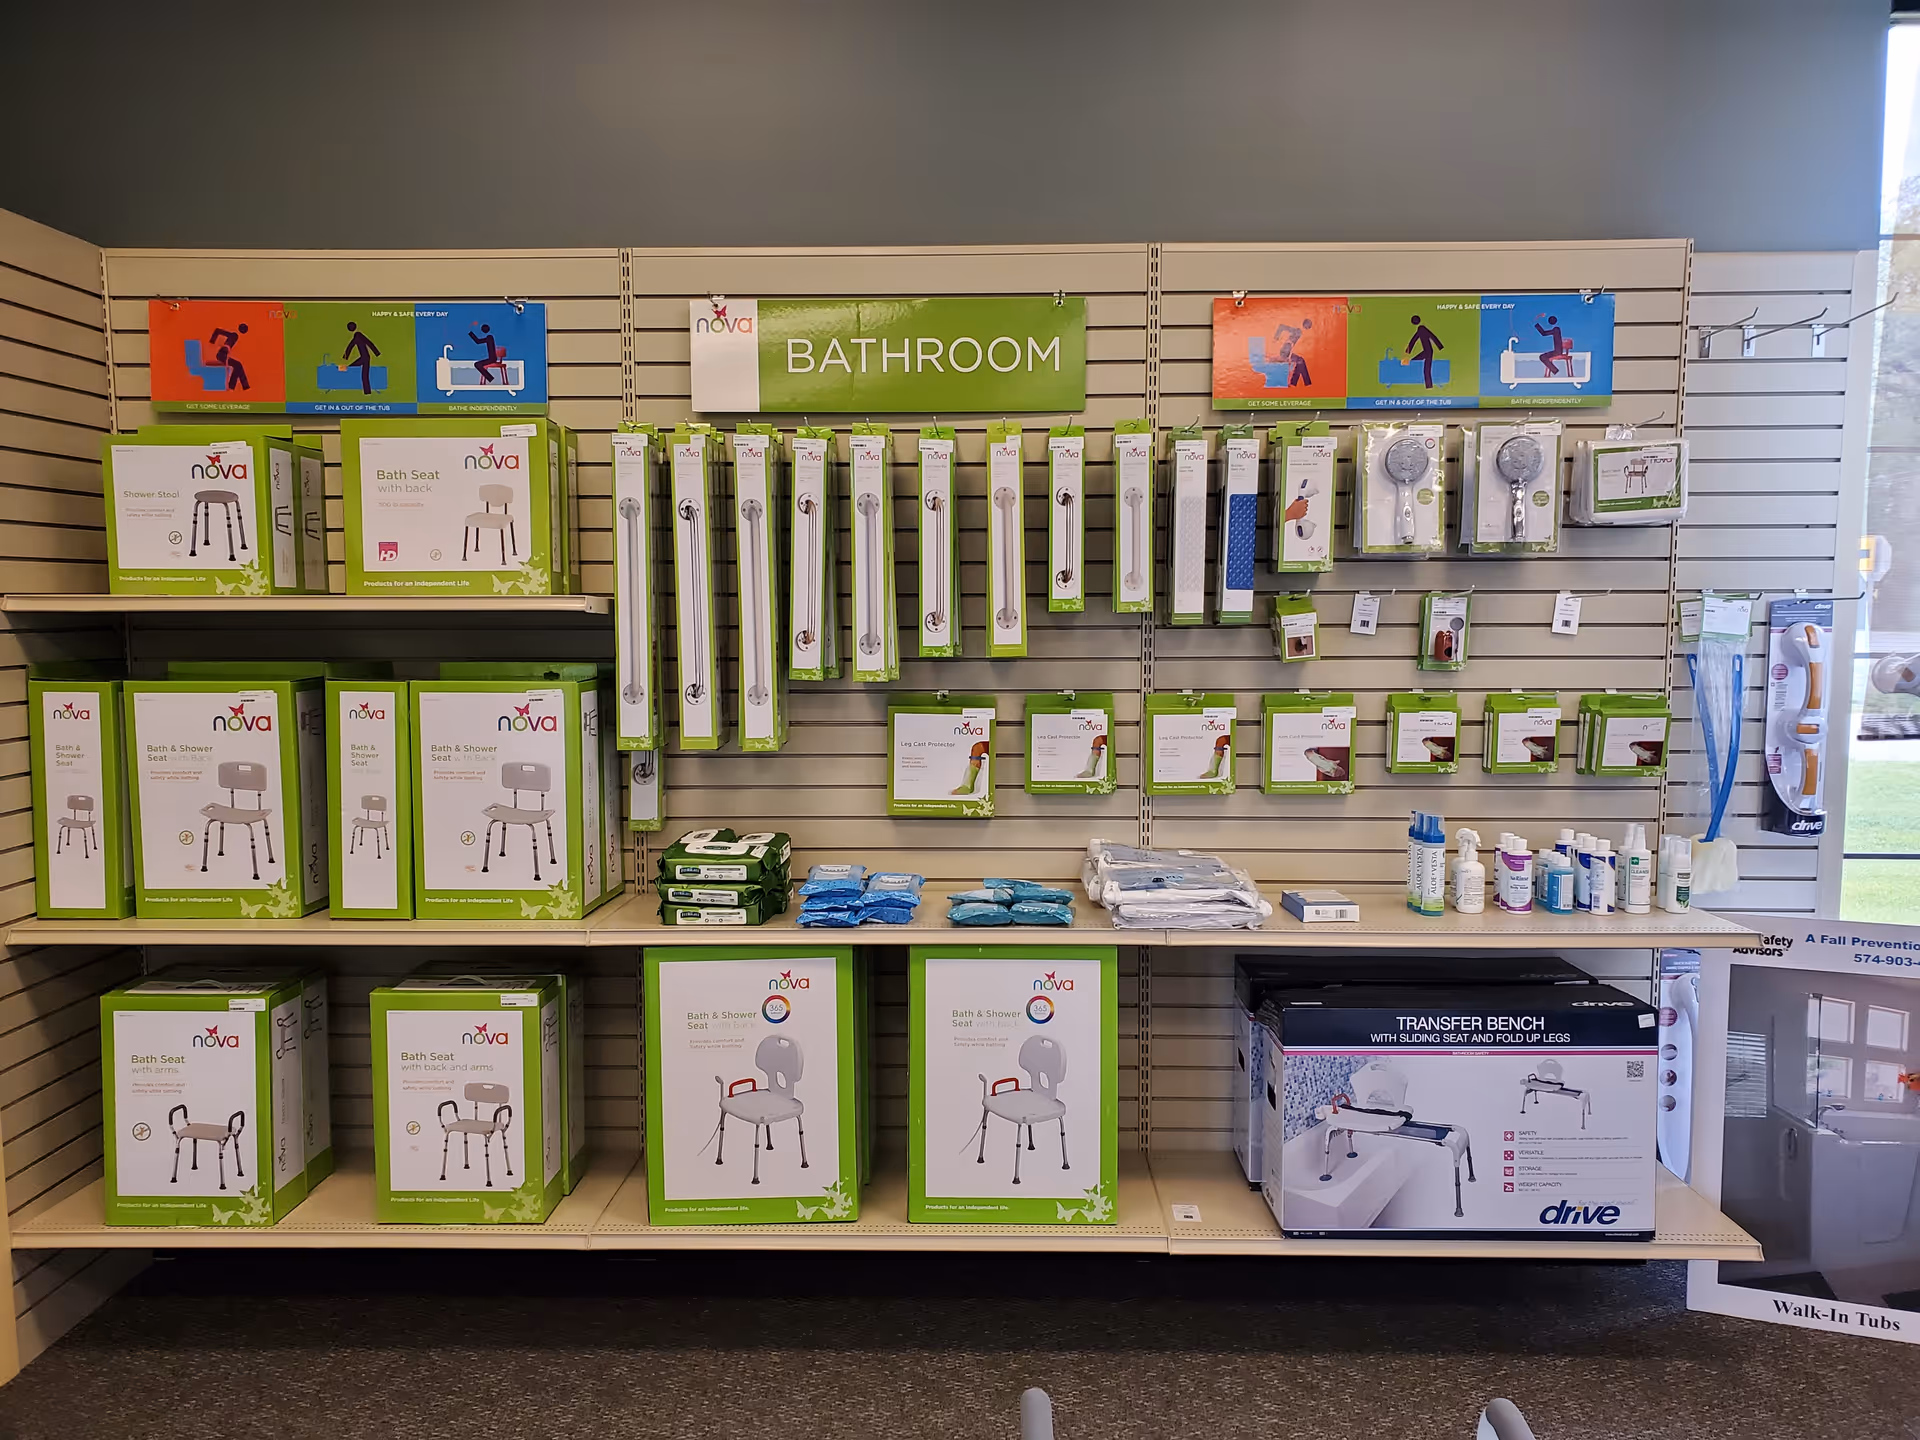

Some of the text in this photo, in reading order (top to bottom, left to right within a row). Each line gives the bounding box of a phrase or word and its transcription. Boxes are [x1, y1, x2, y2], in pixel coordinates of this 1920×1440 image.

[268, 309, 298, 320] nova
[696, 316, 753, 334] nova
[787, 336, 1061, 374] BATHROOM
[314, 404, 390, 412] GET IN & OUT OF THE TUB
[448, 404, 518, 412] BATHE INDEPENDENTLY
[679, 450, 700, 458] nova
[742, 450, 762, 458] nova
[802, 454, 822, 462] nova
[928, 452, 948, 460] nova
[1126, 450, 1146, 458] nova
[1236, 452, 1256, 460] nova
[464, 454, 520, 470] nova
[191, 464, 248, 480] nova
[376, 470, 440, 480] Bath Seat
[378, 484, 432, 493] with back
[123, 490, 180, 499] Shower Stool
[379, 550, 397, 561] HD
[414, 580, 455, 588] Independent
[53, 709, 90, 720] nova
[349, 709, 386, 720] nova
[213, 715, 272, 732] nova
[498, 716, 558, 732] nova
[1079, 723, 1102, 731] nova
[1321, 722, 1346, 730] nova
[954, 726, 983, 736] nova
[146, 744, 214, 753] Bath & Shower
[431, 744, 498, 752] Bath & Shower
[147, 754, 168, 762] Seat
[431, 754, 452, 762] Seat
[1791, 820, 1822, 832] drive
[1430, 851, 1438, 872] VESTA
[1761, 935, 1794, 948] afety
[1805, 934, 1816, 944] A
[1820, 934, 1846, 946] Fall
[1854, 953, 1920, 967] 574-903-
[768, 978, 810, 990] nova
[1033, 979, 1074, 991] nova
[769, 1004, 784, 1012] 365
[1034, 1004, 1047, 1012] 365
[687, 1011, 757, 1020] Bath & Shower
[952, 1010, 1021, 1018] Bath & Shower
[688, 1022, 708, 1030] Seat
[952, 1020, 972, 1028] Seat
[1396, 1016, 1545, 1031] TRANSFER BENCH
[192, 1035, 239, 1048] nova
[462, 1032, 508, 1045] nova
[1370, 1034, 1570, 1043] WITH SLIDING SEAT AND FOLD UP LEGS
[131, 1055, 185, 1064] Bath Seat
[401, 1052, 454, 1061] Bath Seat
[131, 1066, 152, 1074] with
[401, 1064, 422, 1072] with
[424, 1064, 447, 1072] back
[449, 1064, 468, 1072] and
[1539, 1200, 1621, 1225] drive
[1772, 1299, 1901, 1332] Walk-In Tubs
